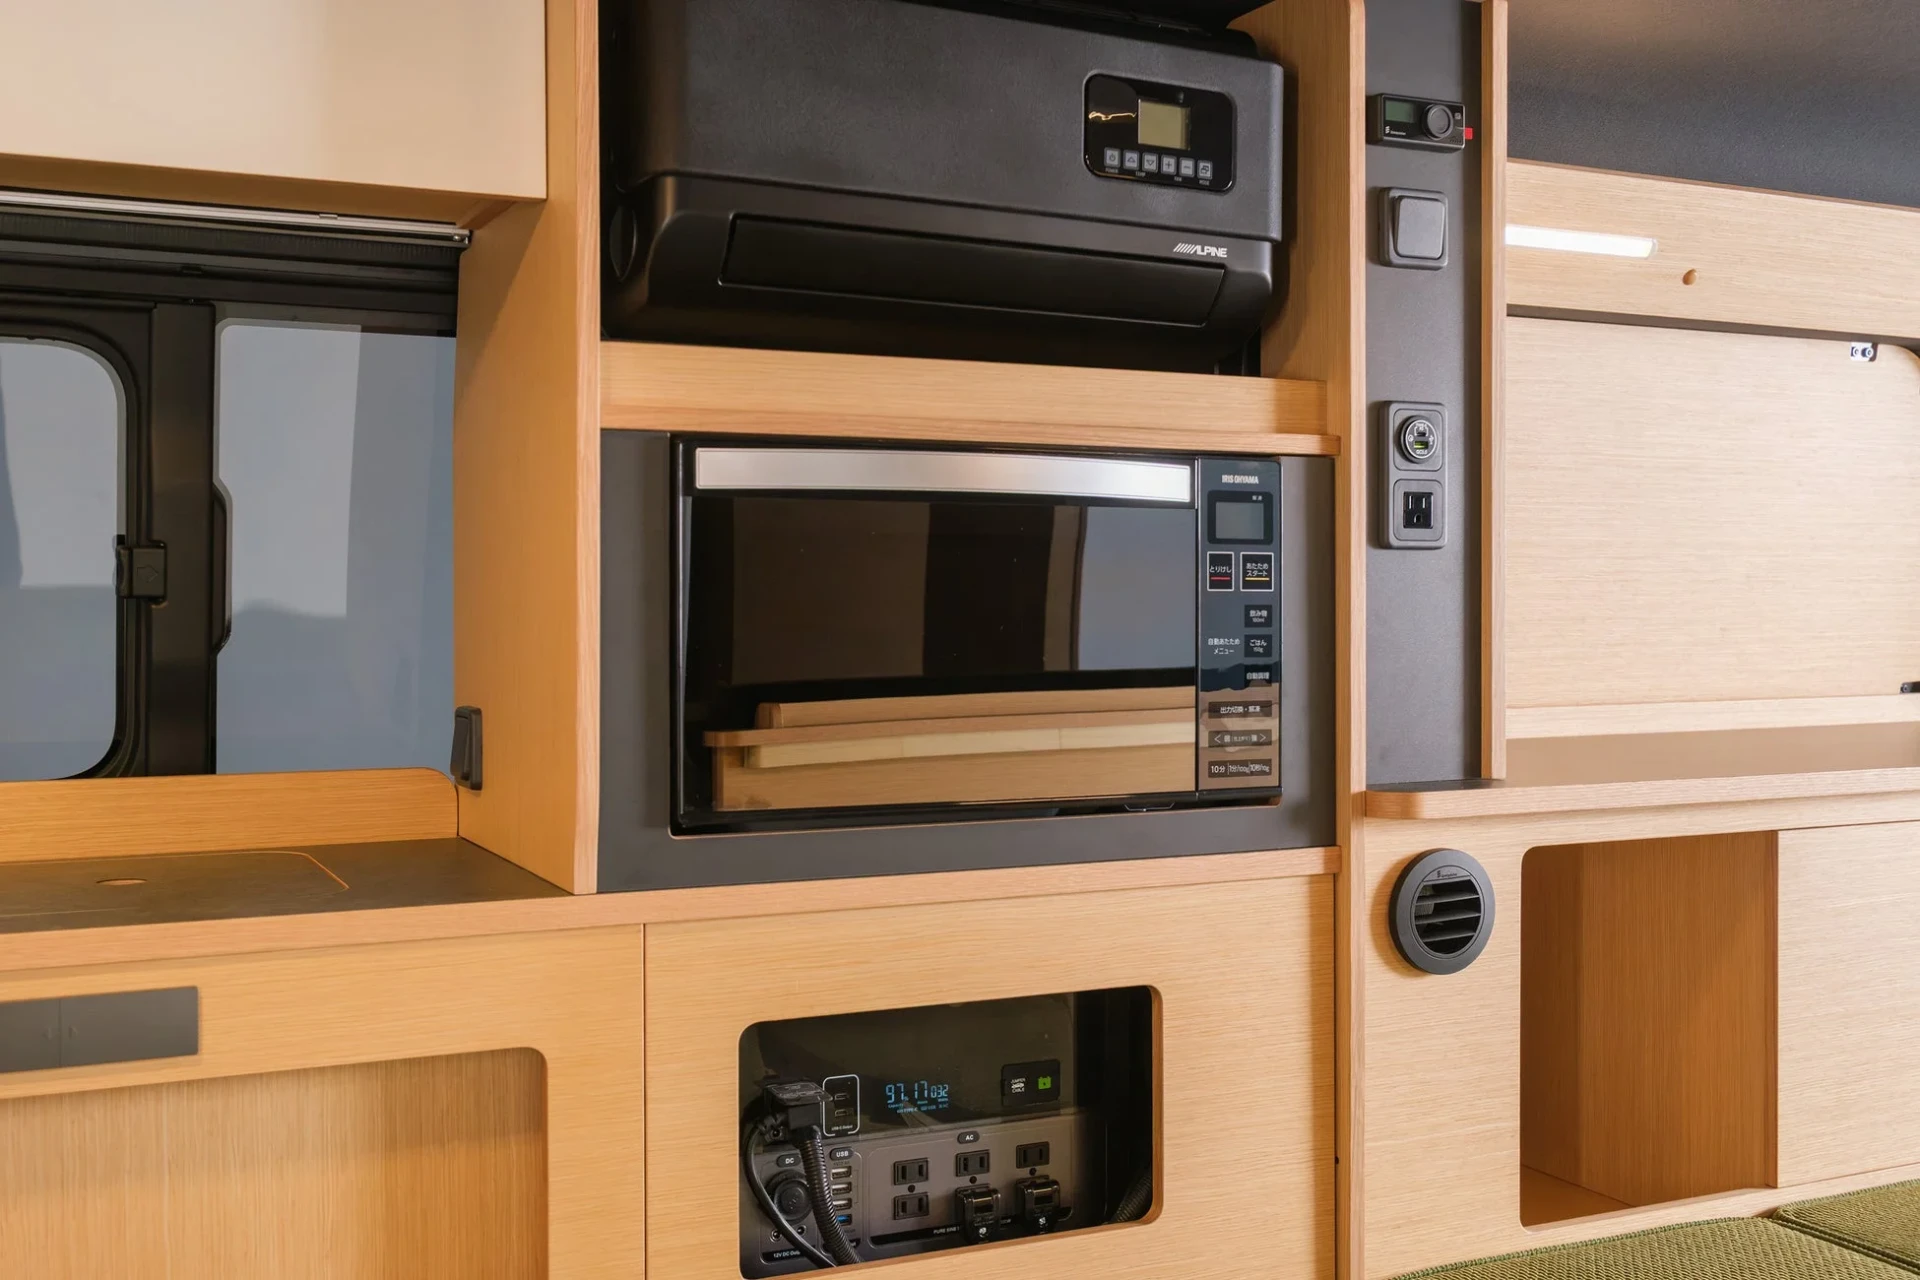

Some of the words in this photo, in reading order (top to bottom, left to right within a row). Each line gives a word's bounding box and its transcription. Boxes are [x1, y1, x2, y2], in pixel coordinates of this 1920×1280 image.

[1190, 244, 1228, 258] ALPINE
[1222, 475, 1234, 484] IRIS
[1234, 475, 1259, 484] OHYAMA
[1209, 565, 1232, 573] とりけし
[1246, 562, 1269, 570] あたため
[1213, 647, 1235, 655] メニュー
[1210, 765, 1226, 774] 10分
[836, 1150, 849, 1158] USB
